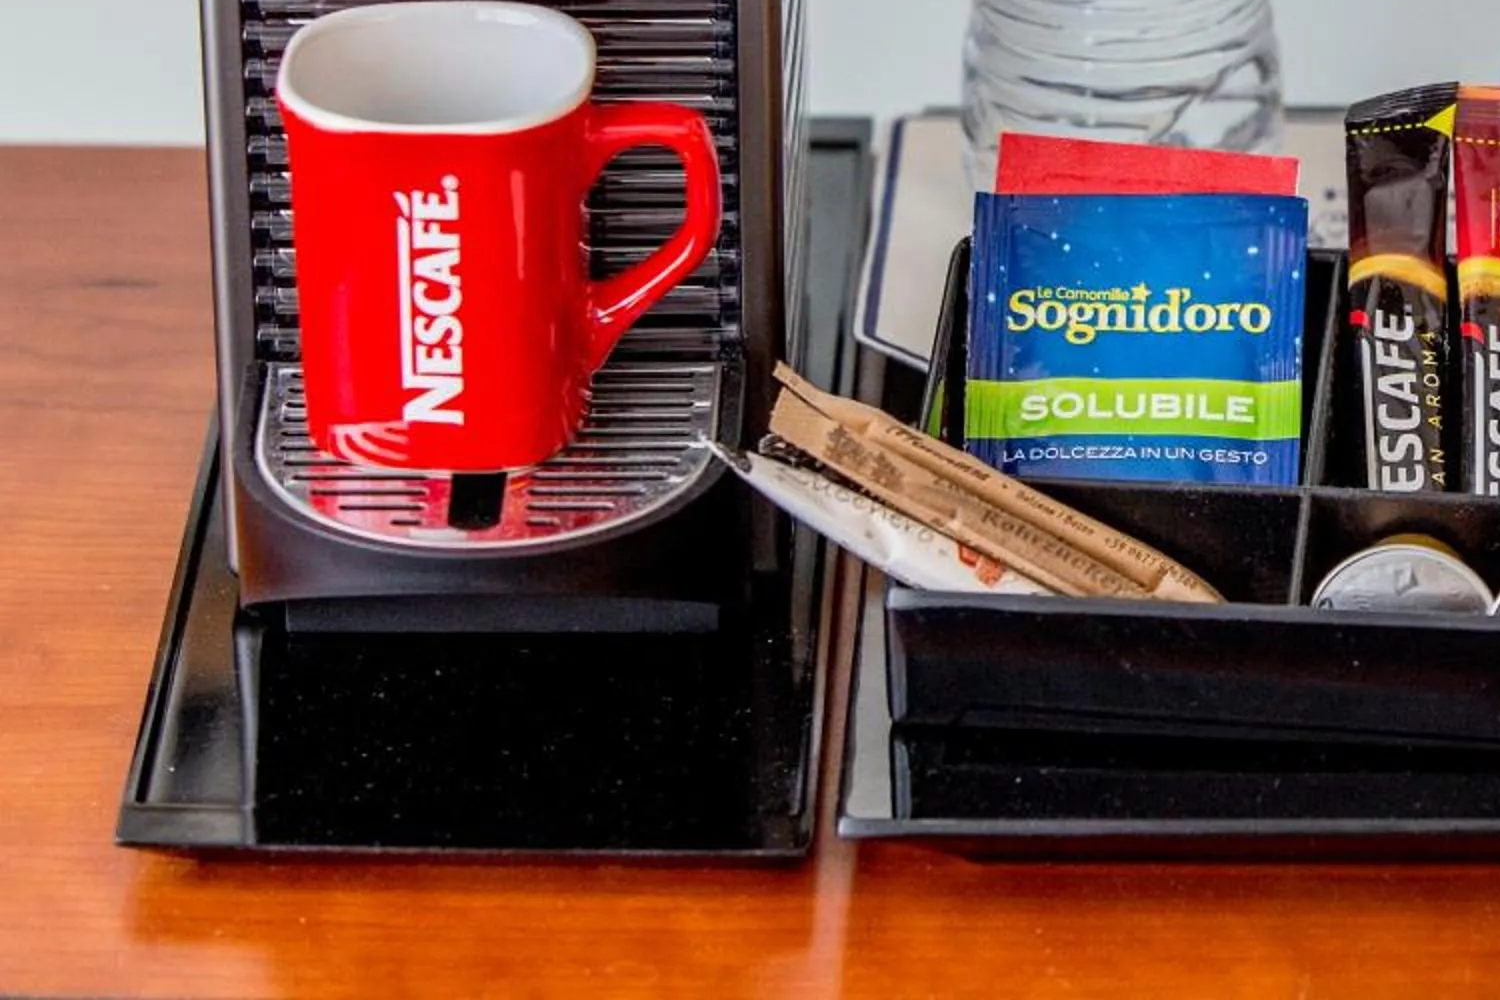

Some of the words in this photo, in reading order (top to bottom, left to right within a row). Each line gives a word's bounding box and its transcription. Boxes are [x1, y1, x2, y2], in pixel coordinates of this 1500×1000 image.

[1037, 285, 1052, 299] Le
[1055, 286, 1131, 301] Camomille
[1420, 331, 1444, 430] AROMA
[1020, 392, 1255, 424] SOLUBILE
[1003, 448, 1026, 464] LA
[1029, 446, 1137, 461] DOLCEZZA
[1141, 447, 1161, 460] IN
[1166, 447, 1194, 461] UN
[1199, 450, 1268, 466] GESTO
